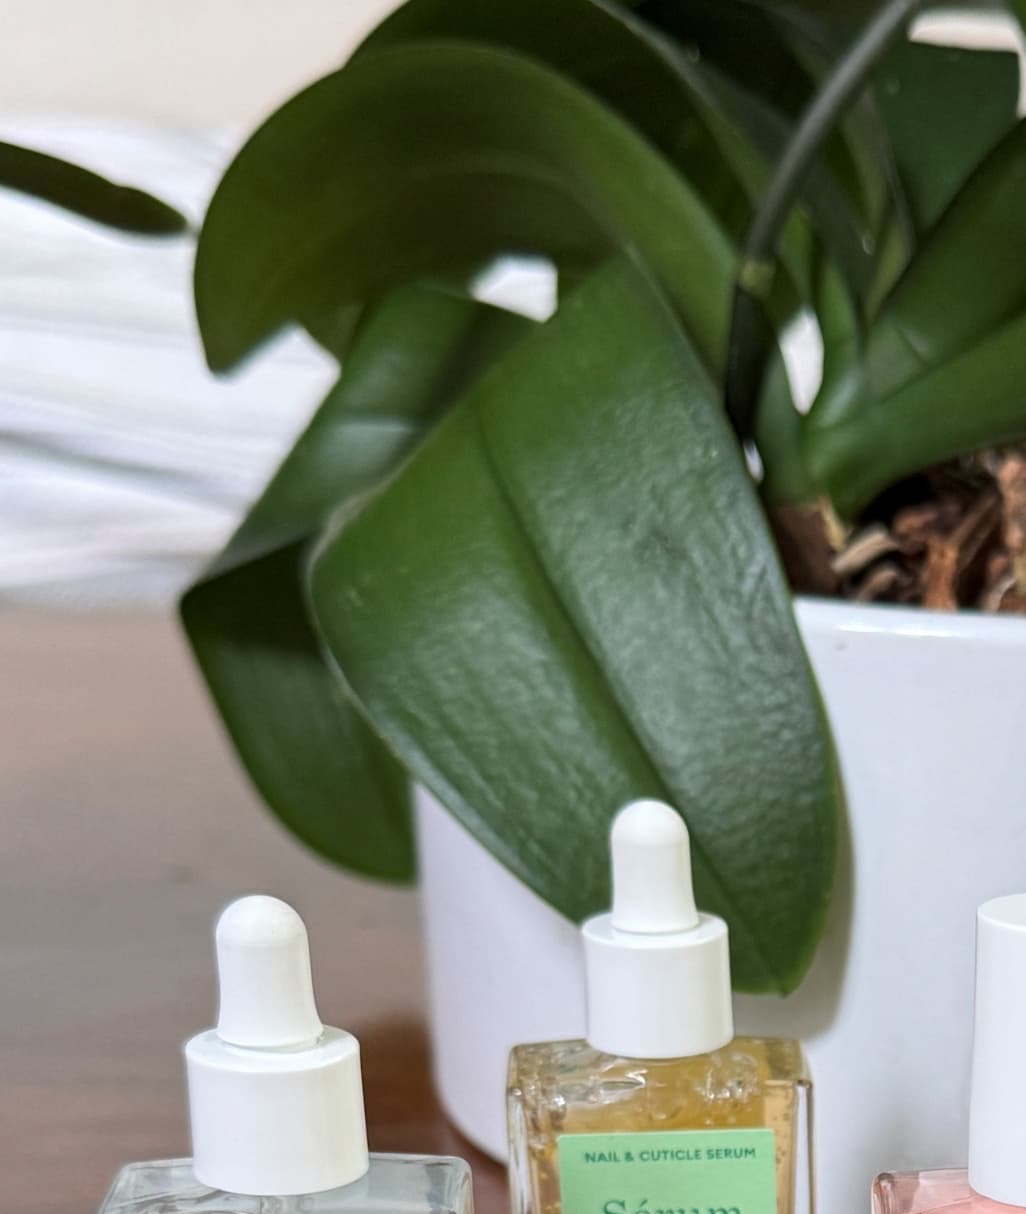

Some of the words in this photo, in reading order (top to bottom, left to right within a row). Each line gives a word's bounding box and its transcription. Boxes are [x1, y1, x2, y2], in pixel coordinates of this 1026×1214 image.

[584, 1151, 620, 1163] NAIL
[625, 1151, 634, 1162] &
[639, 1149, 702, 1162] CUTICLE
[706, 1147, 756, 1160] SERUM
